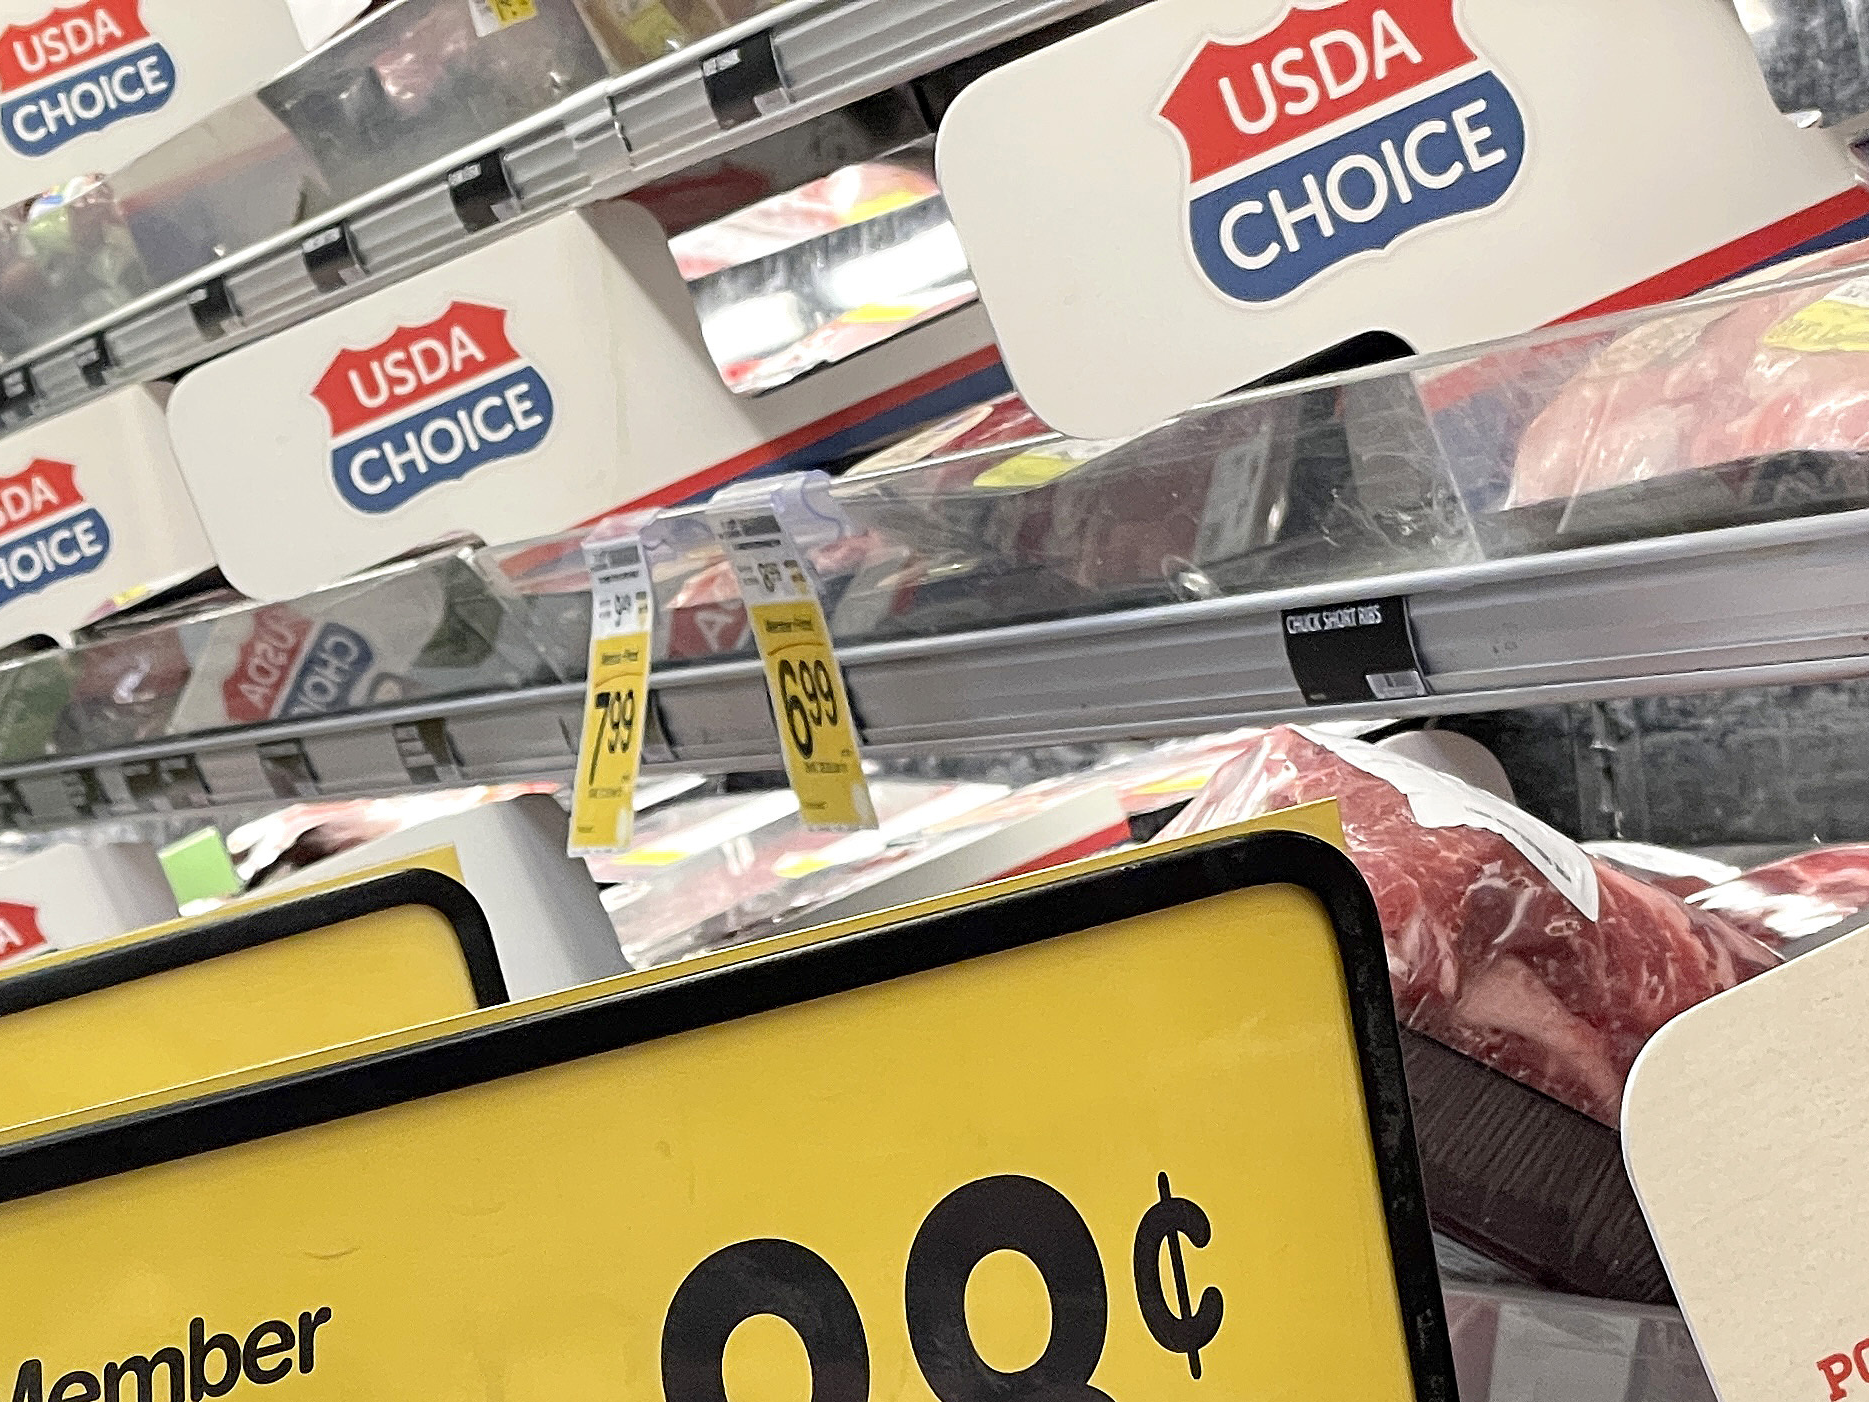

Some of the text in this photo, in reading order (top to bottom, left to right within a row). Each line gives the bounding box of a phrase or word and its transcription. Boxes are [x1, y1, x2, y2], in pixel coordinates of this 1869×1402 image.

[12, 8, 123, 74] USDA
[1219, 9, 1422, 136] USDA
[11, 55, 169, 142] CHOICE
[1219, 97, 1506, 271] CHOICE
[347, 325, 485, 408] USDA
[349, 388, 543, 494] CHOICE
[1286, 604, 1382, 634] CHUCK SHORT RIBS
